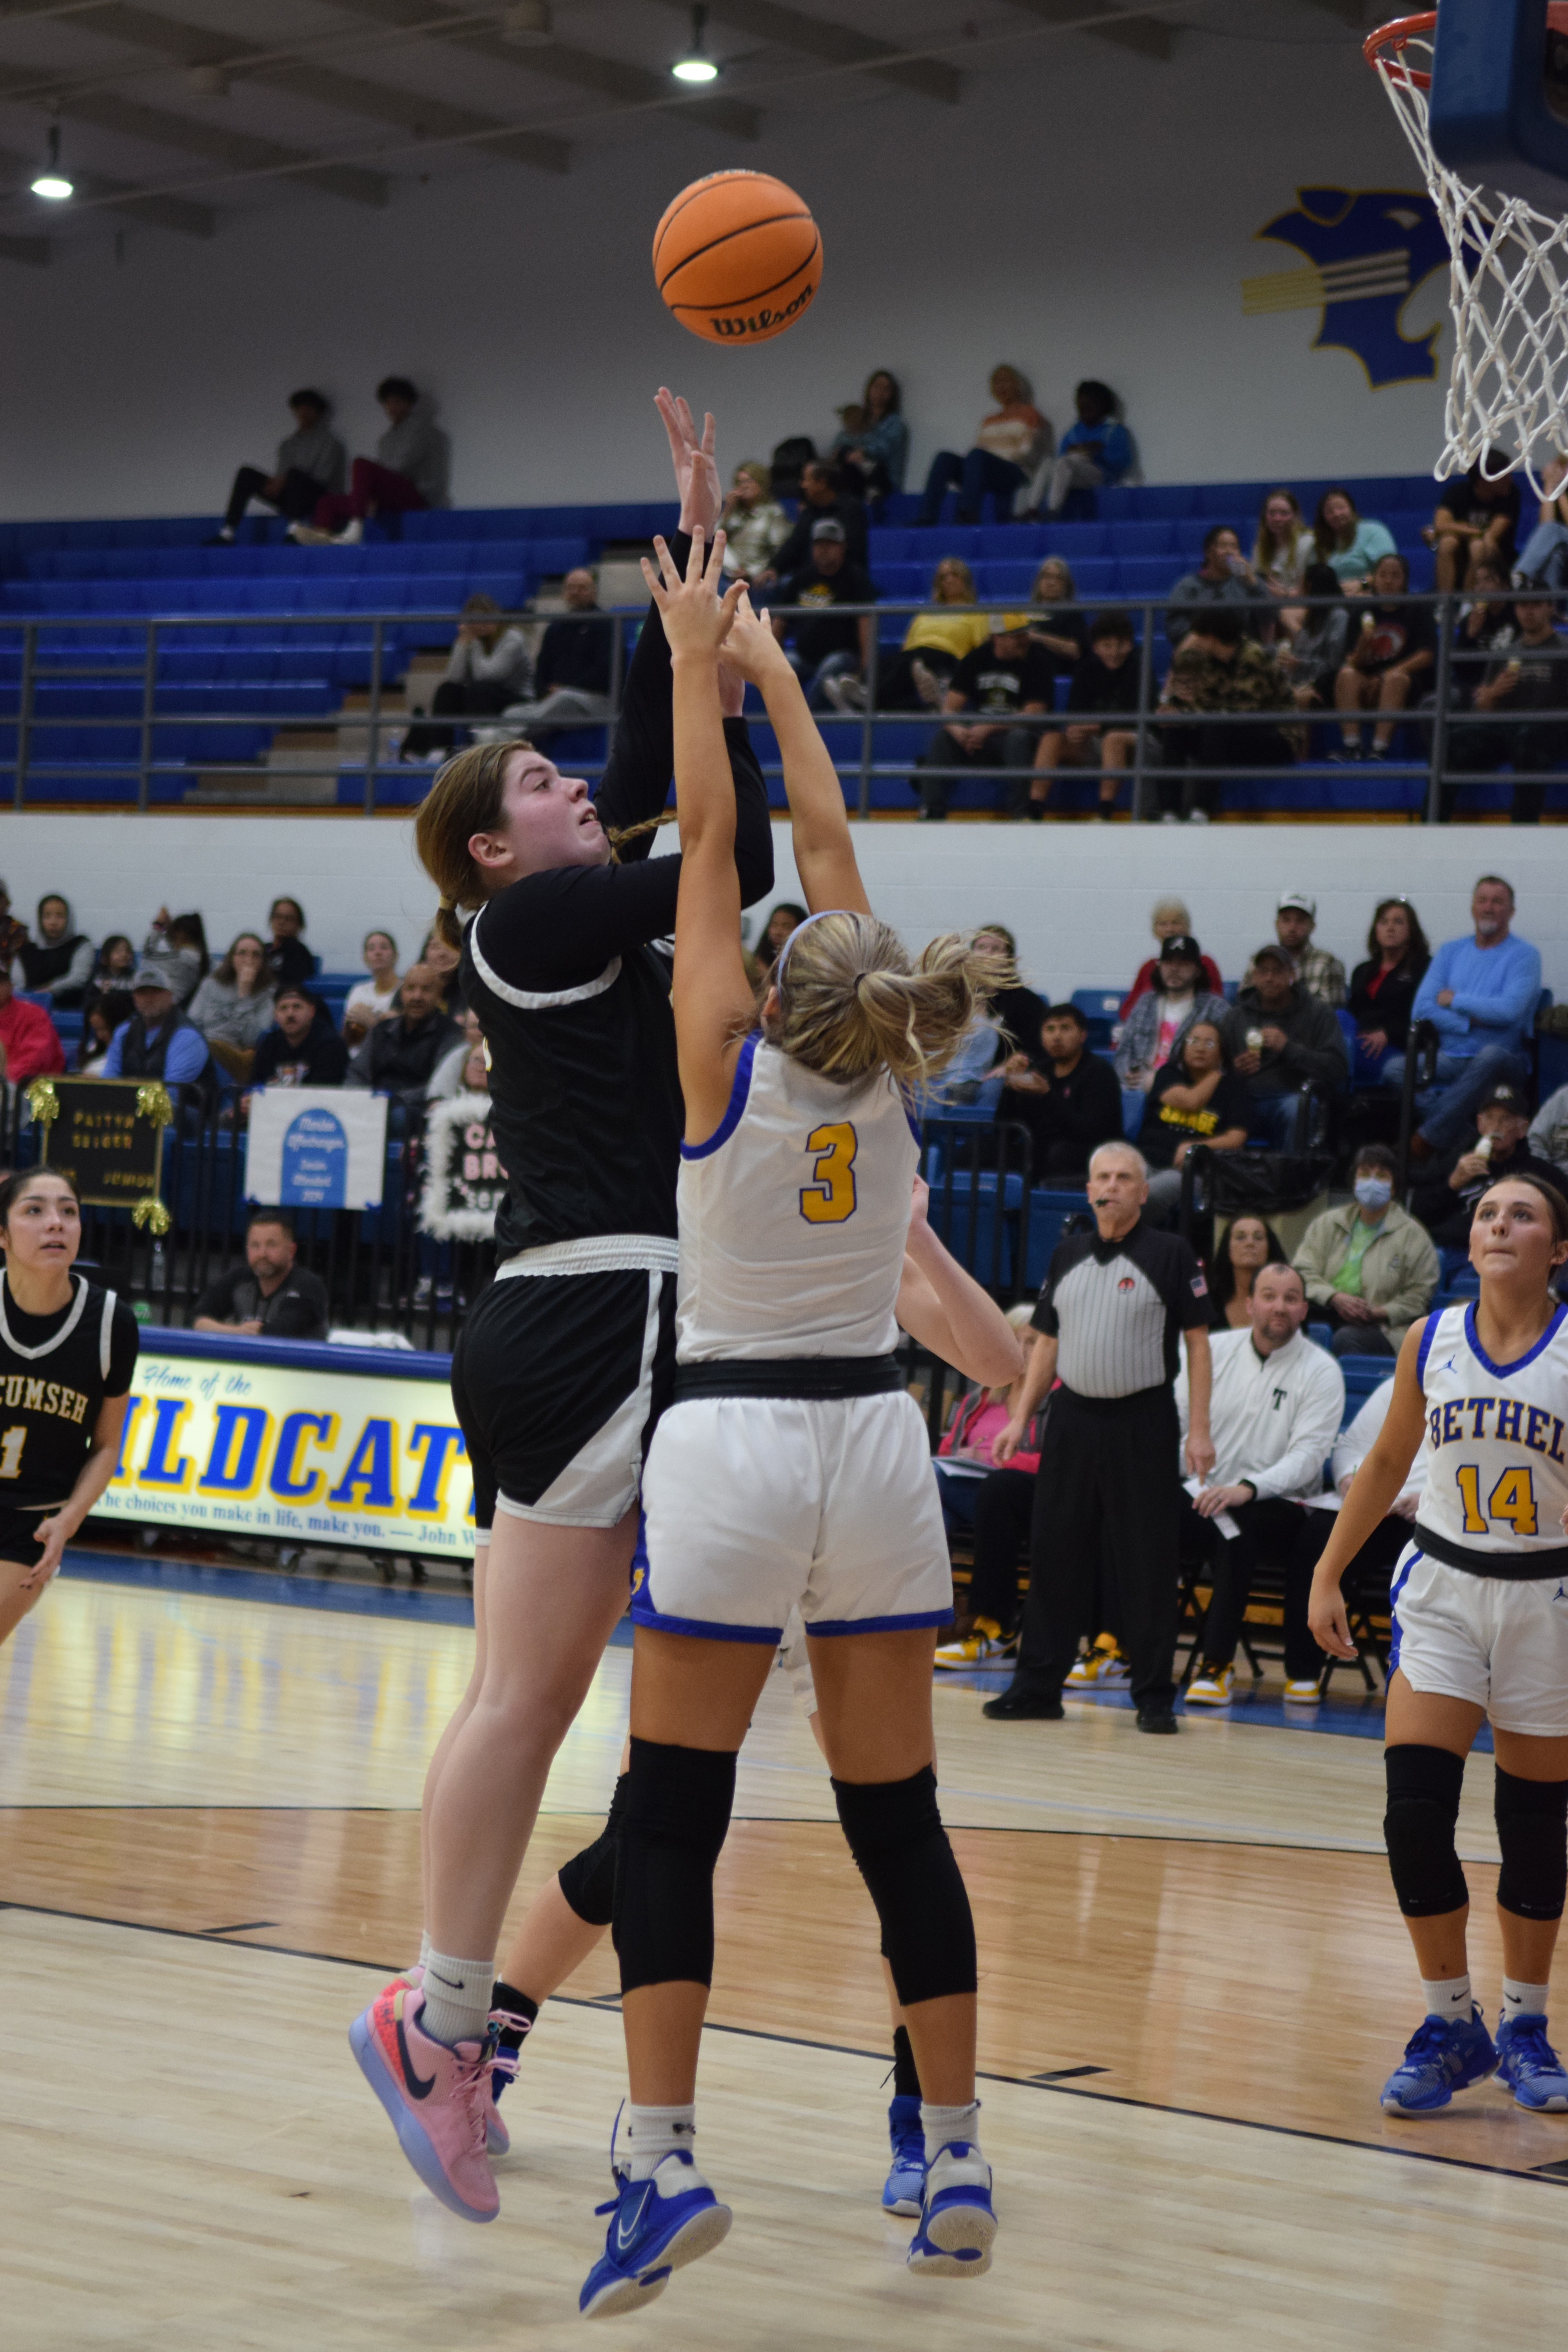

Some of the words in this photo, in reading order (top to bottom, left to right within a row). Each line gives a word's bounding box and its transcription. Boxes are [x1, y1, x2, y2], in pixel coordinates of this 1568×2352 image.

[709, 283, 813, 336] Wilson
[799, 1120, 858, 1225] 3
[143, 1364, 192, 1388] Home
[200, 1371, 220, 1401] of
[225, 1374, 252, 1396] the
[1273, 1387, 1287, 1411] T
[0, 1425, 28, 1479] 1
[1428, 1396, 1566, 1466] BETHEL
[111, 1394, 477, 1526] ILDCAT
[125, 1494, 177, 1515] choices
[182, 1503, 207, 1520] you
[213, 1503, 252, 1524] make
[257, 1508, 271, 1524] in
[276, 1509, 304, 1530] life,
[308, 1514, 350, 1534] make
[418, 1524, 456, 1546] John
[1455, 1464, 1539, 1536] 14
